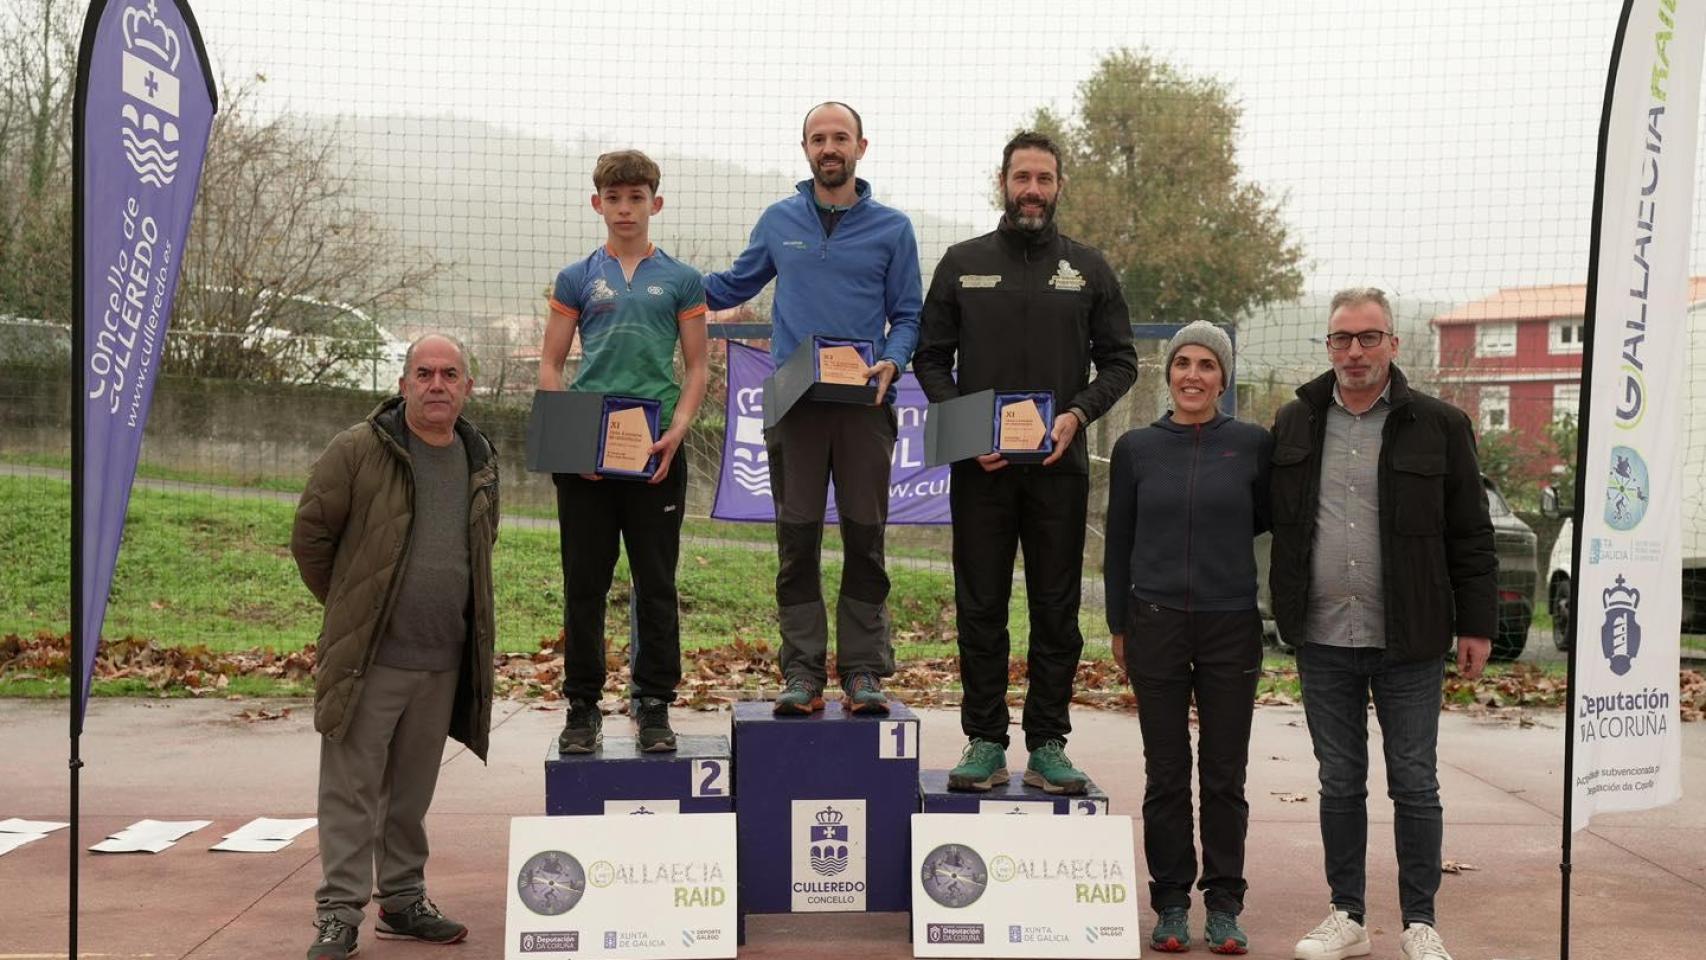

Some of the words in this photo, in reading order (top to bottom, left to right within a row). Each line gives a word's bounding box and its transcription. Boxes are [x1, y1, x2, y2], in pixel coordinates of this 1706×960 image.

[122, 196, 140, 240] de
[127, 239, 172, 428] www.culleredo.es
[1599, 711, 1667, 739] CORUÑA
[891, 723, 905, 757] 1
[700, 761, 722, 796] 2
[674, 886, 726, 908] RAID
[793, 881, 866, 893] CULLEREDO
[1075, 883, 1127, 904] RAID
[807, 895, 855, 904] CONCELLO
[620, 931, 648, 940] XUNTA
[1024, 927, 1053, 935] XUNTA
[632, 940, 665, 948] GALICIA
